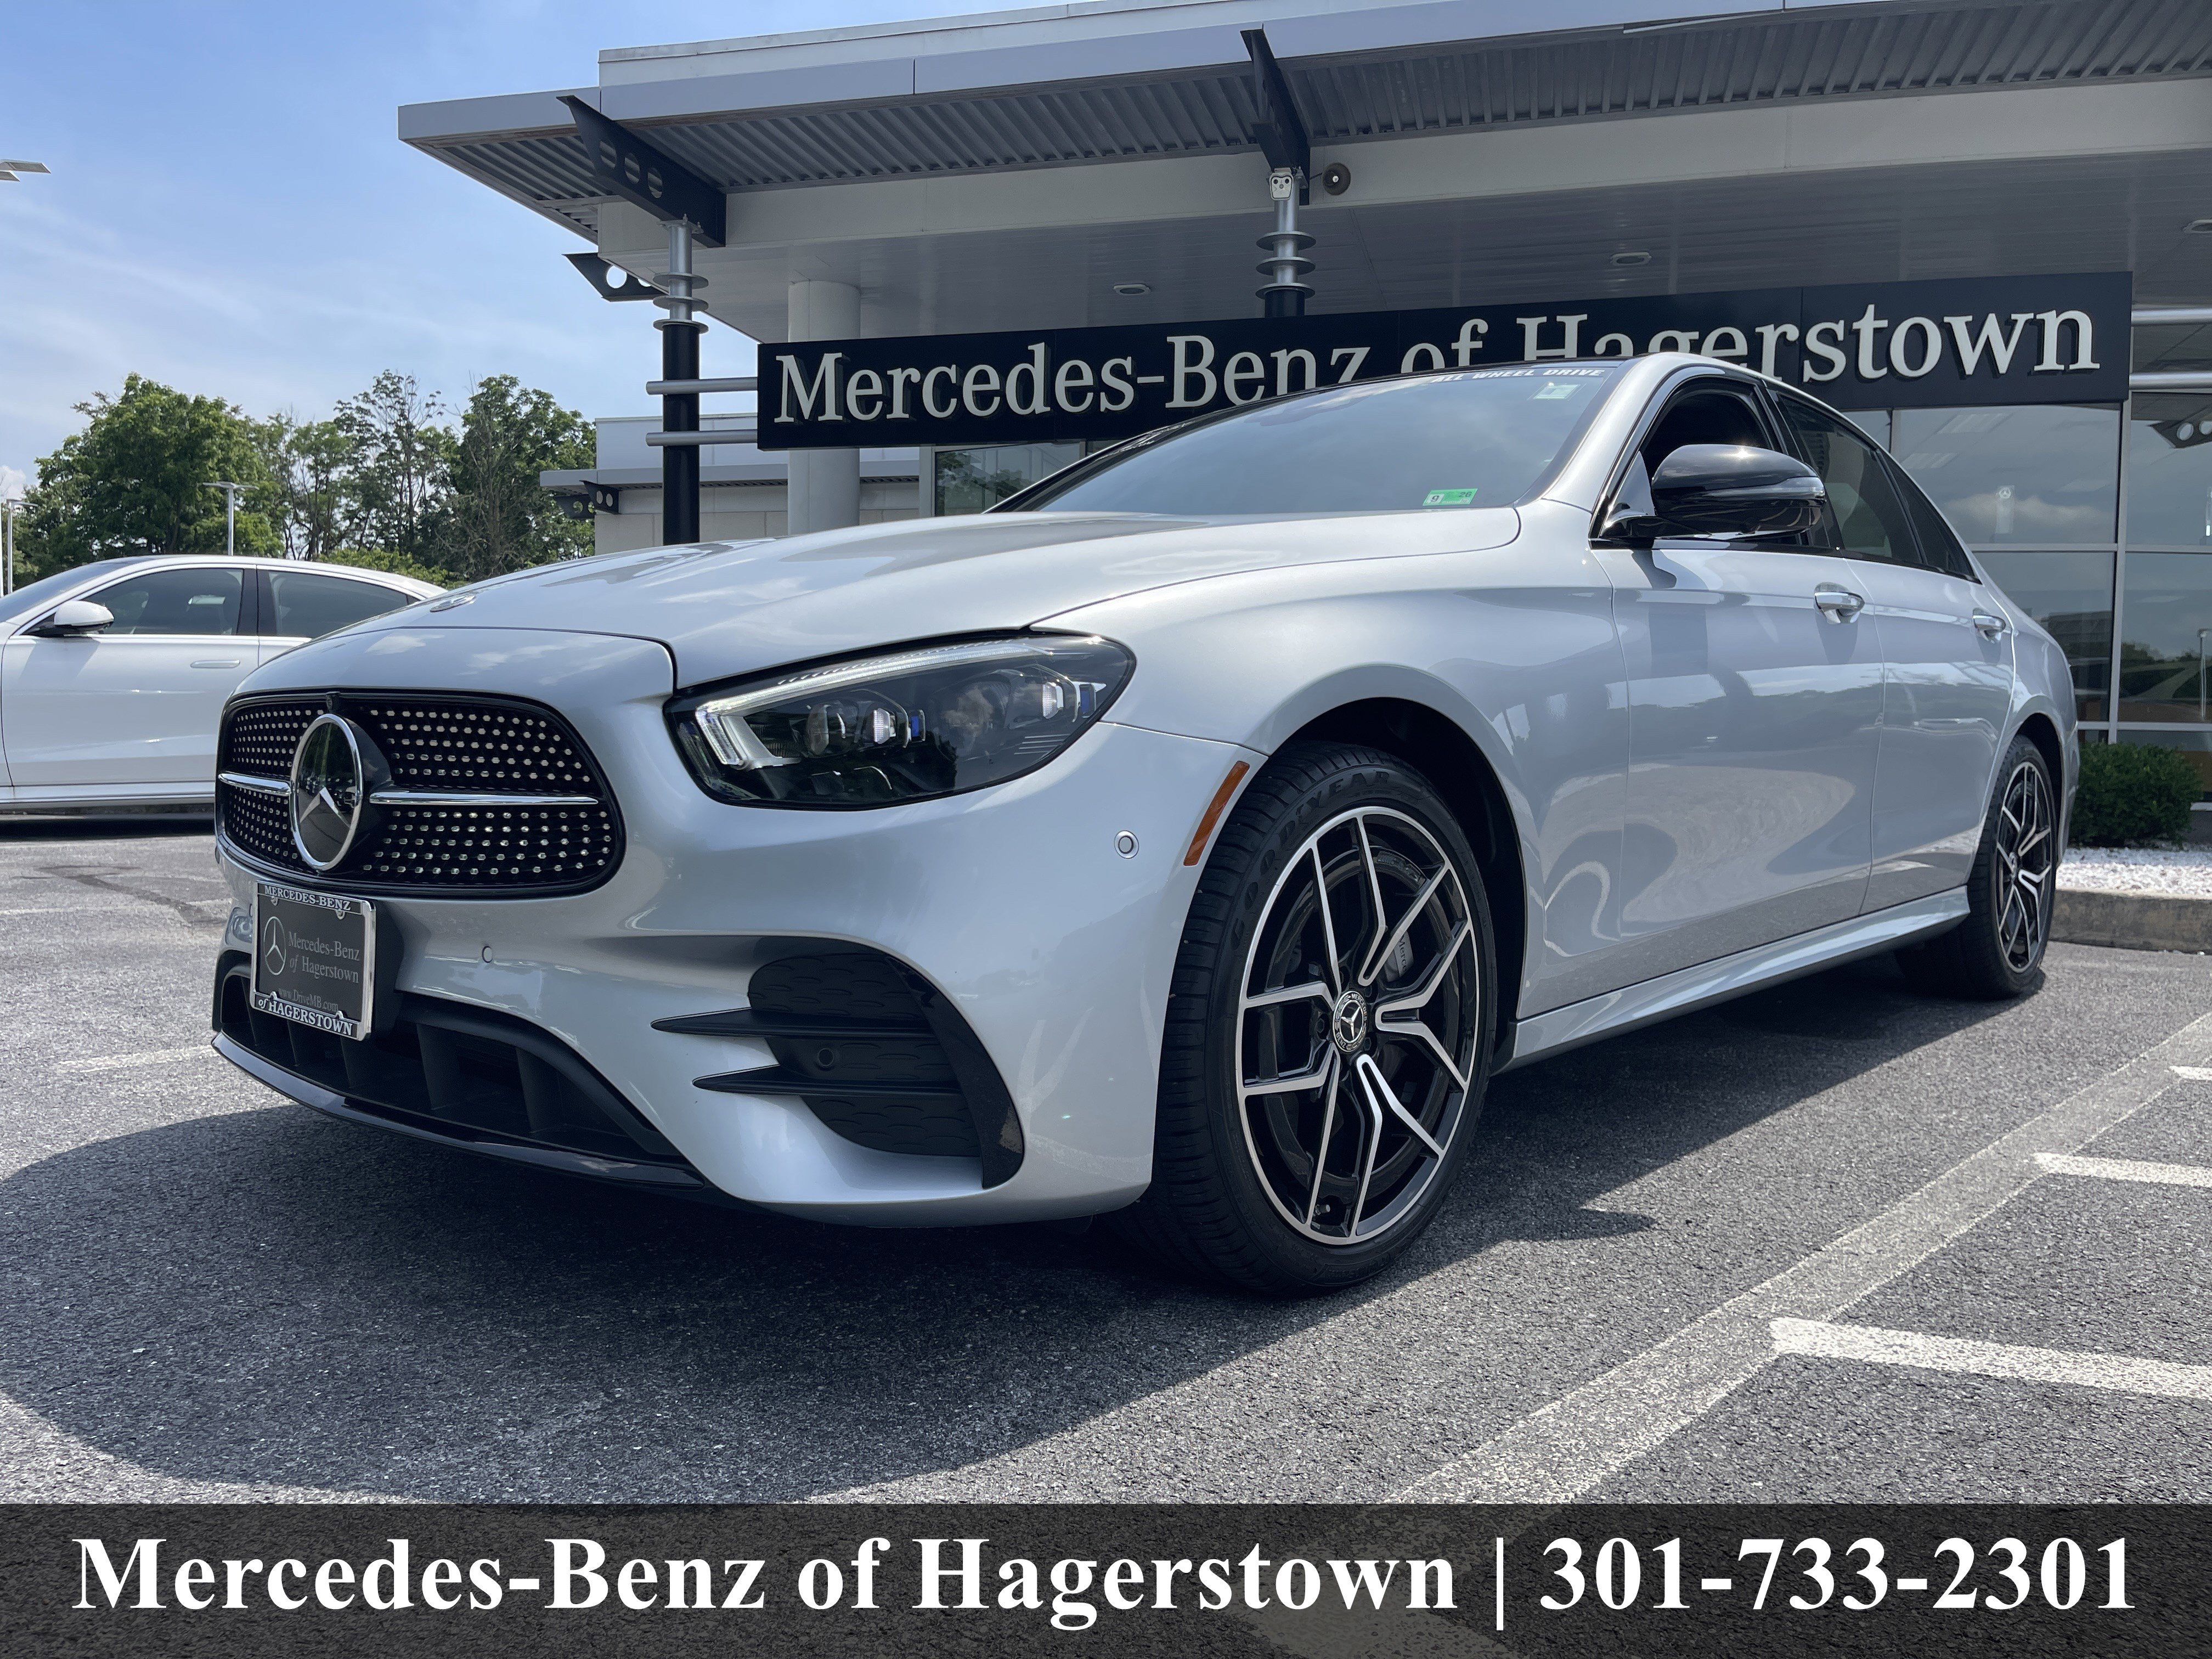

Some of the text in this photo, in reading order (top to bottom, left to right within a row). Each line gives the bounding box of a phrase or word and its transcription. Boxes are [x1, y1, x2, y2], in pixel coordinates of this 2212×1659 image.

[774, 335, 1370, 423] Mercedes-Benz
[1401, 318, 1489, 374] of
[1431, 374, 1464, 383] ALL
[1472, 369, 1535, 379] WHEEL
[264, 885, 352, 911] MERCEDES-BENZ
[288, 931, 360, 961] Mercedes-Benz
[290, 954, 359, 984] of Hagerstown
[258, 998, 353, 1036] of HAGERSTOWN
[1336, 1031, 1346, 1049] BENZ
